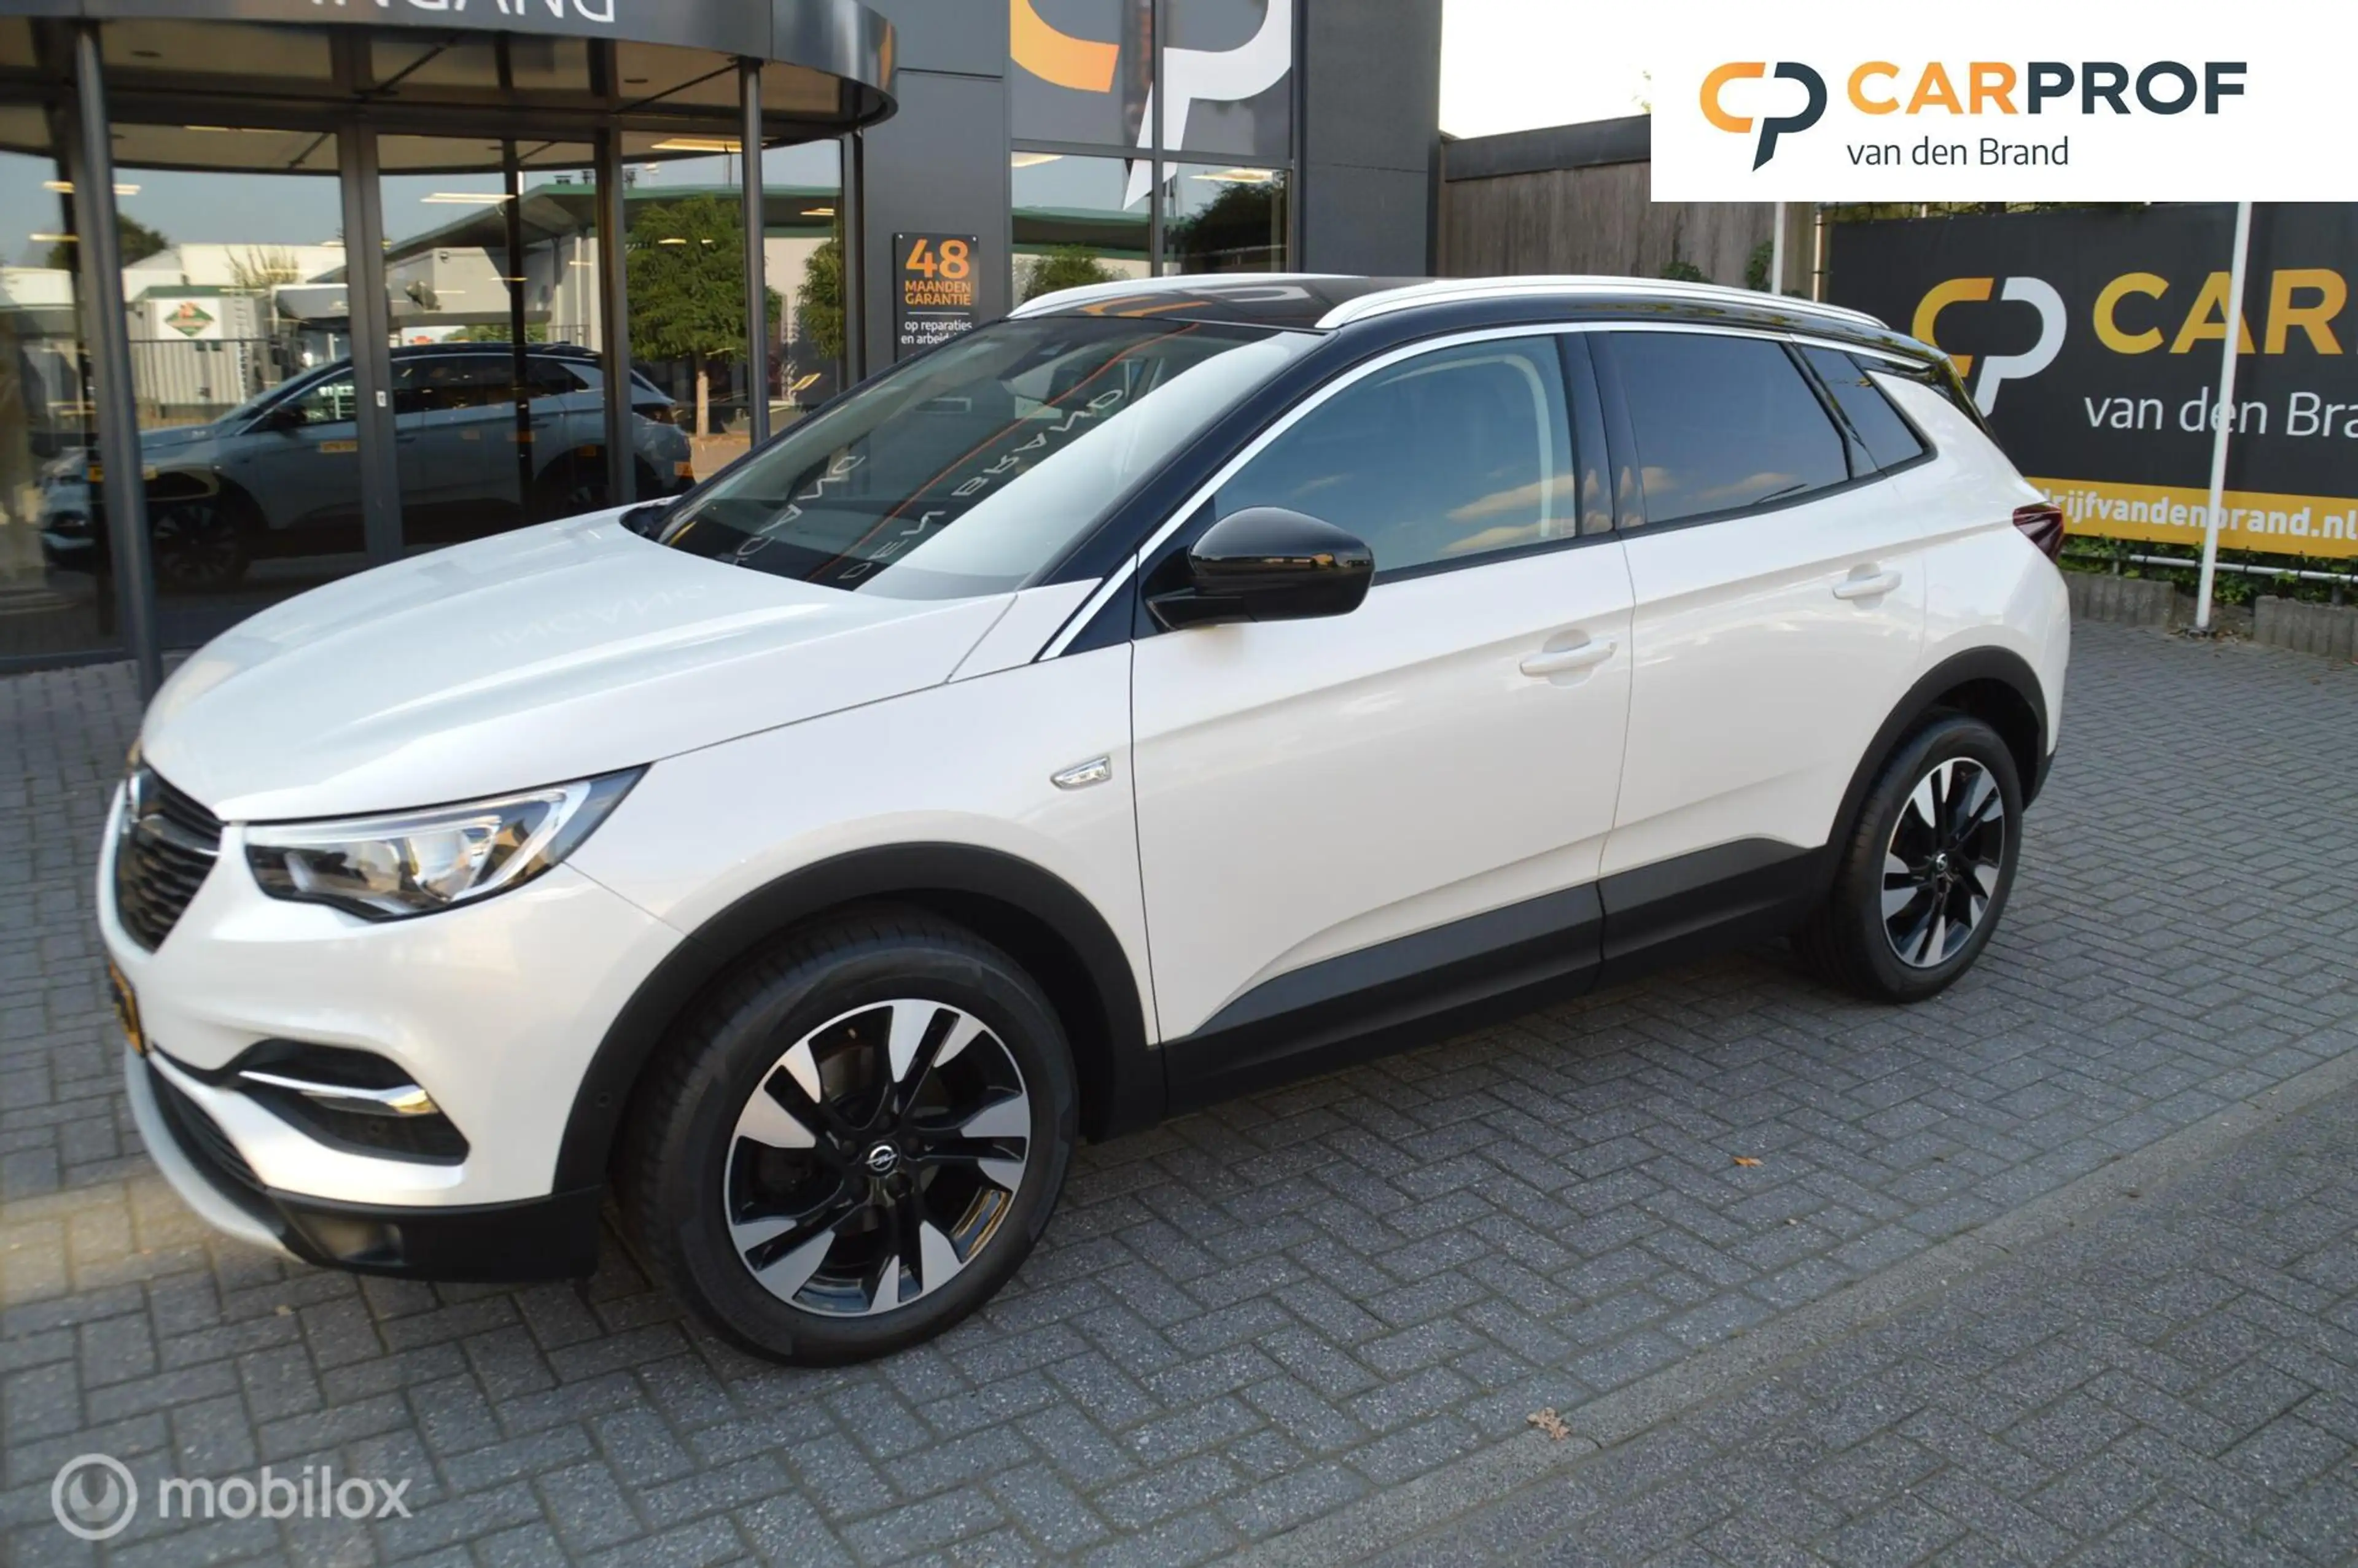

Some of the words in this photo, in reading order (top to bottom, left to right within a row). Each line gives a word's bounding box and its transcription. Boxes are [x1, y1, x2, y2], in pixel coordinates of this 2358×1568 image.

[905, 238, 970, 279] 48
[905, 280, 971, 293] MAANDEN
[905, 293, 972, 306] GARANTIE
[905, 320, 919, 333] op
[920, 319, 973, 333] reparaties
[901, 335, 914, 345] en
[2084, 397, 2164, 430] van
[2179, 386, 2268, 435] den
